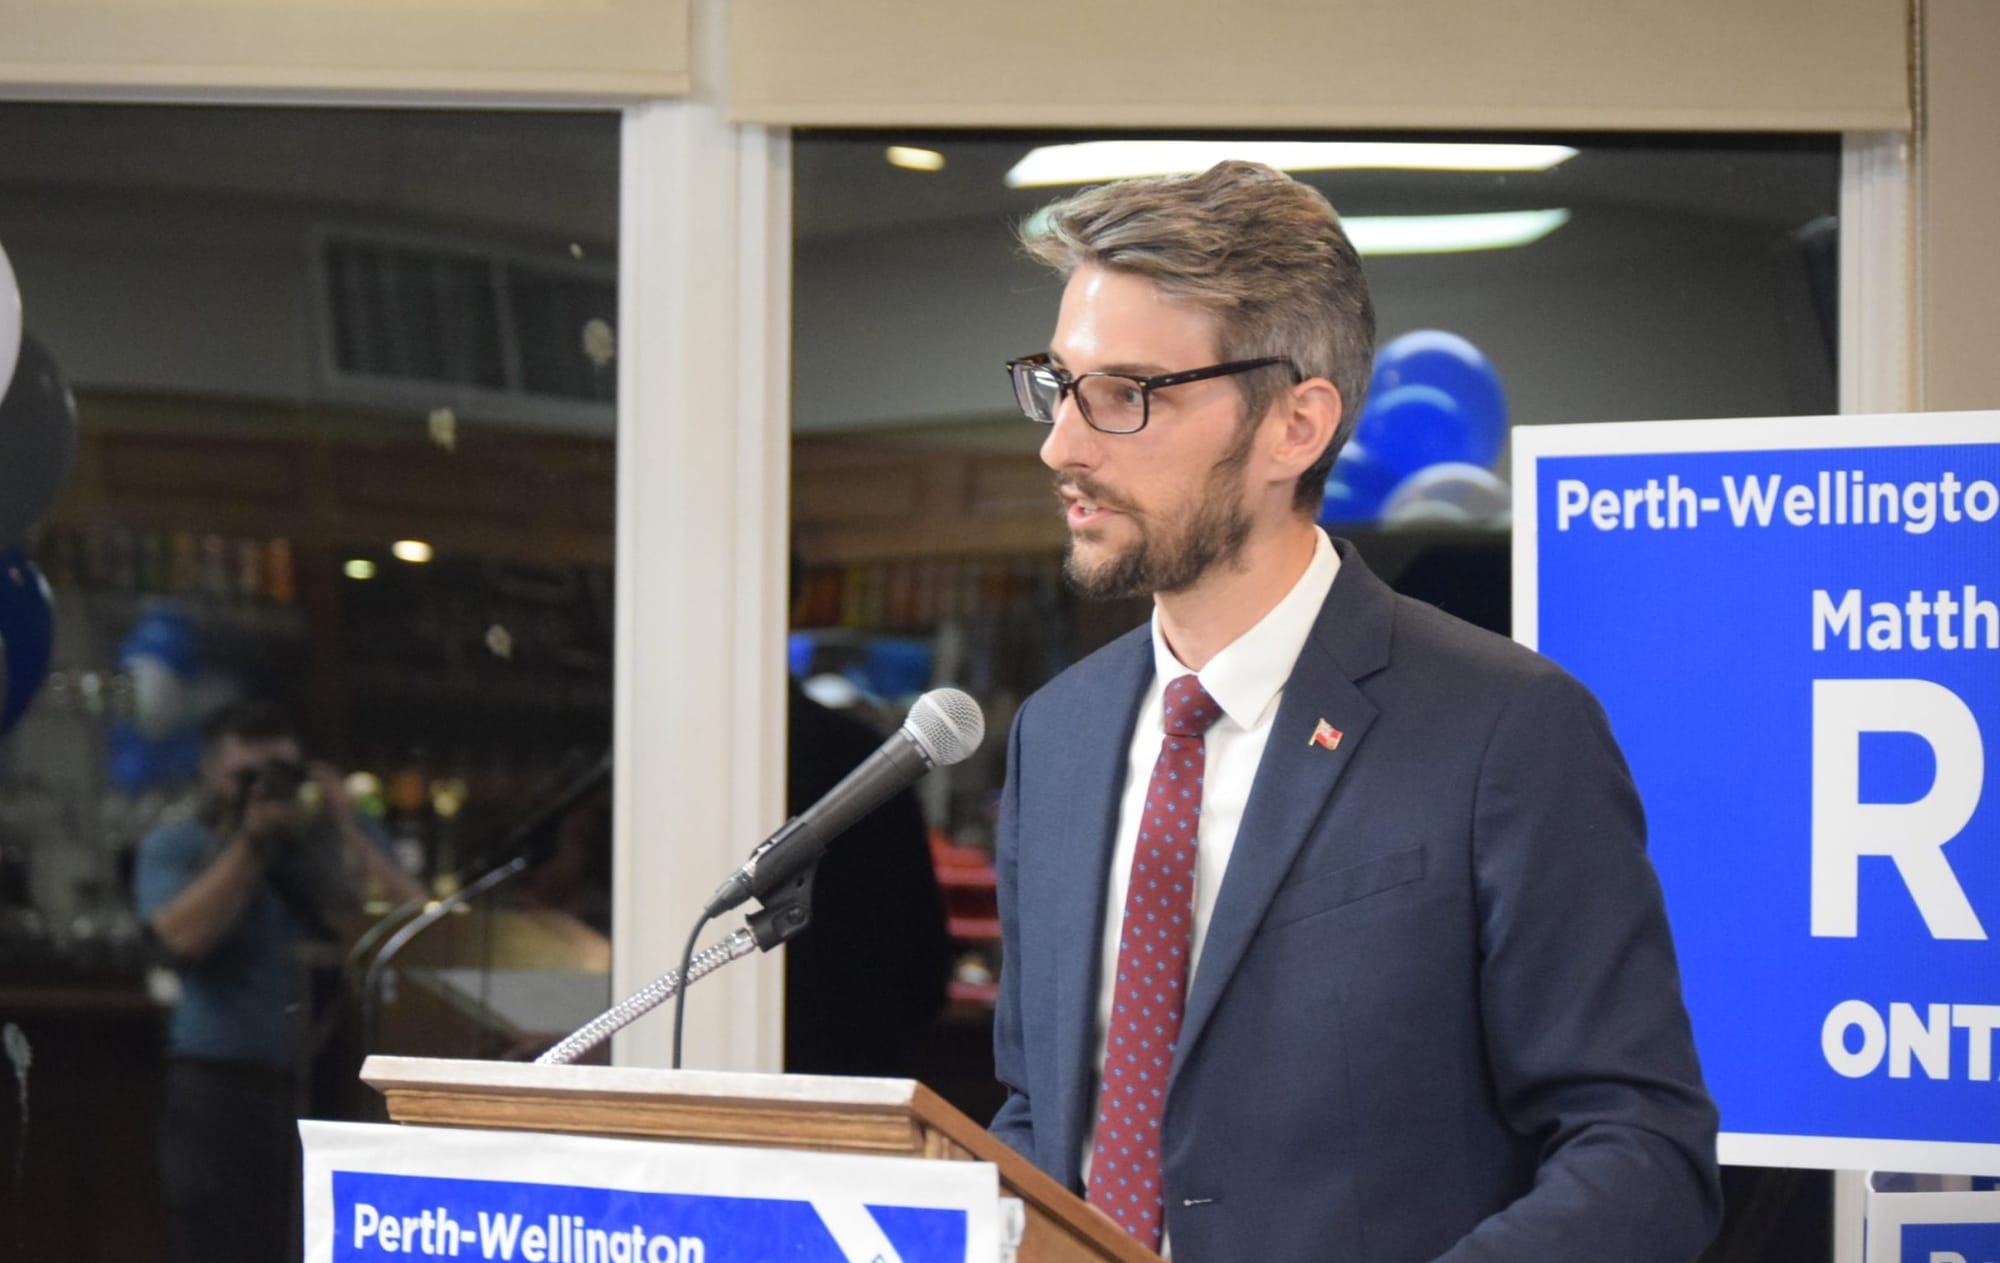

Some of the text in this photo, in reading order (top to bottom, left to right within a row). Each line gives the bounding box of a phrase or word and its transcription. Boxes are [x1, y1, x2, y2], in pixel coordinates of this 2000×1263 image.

[1557, 470, 2000, 534] Perth-Wellingto
[1812, 585, 2000, 650] Matth
[1810, 679, 1989, 940] R
[1821, 999, 2000, 1081] ONT
[354, 1203, 705, 1263] Perth-Wellington
